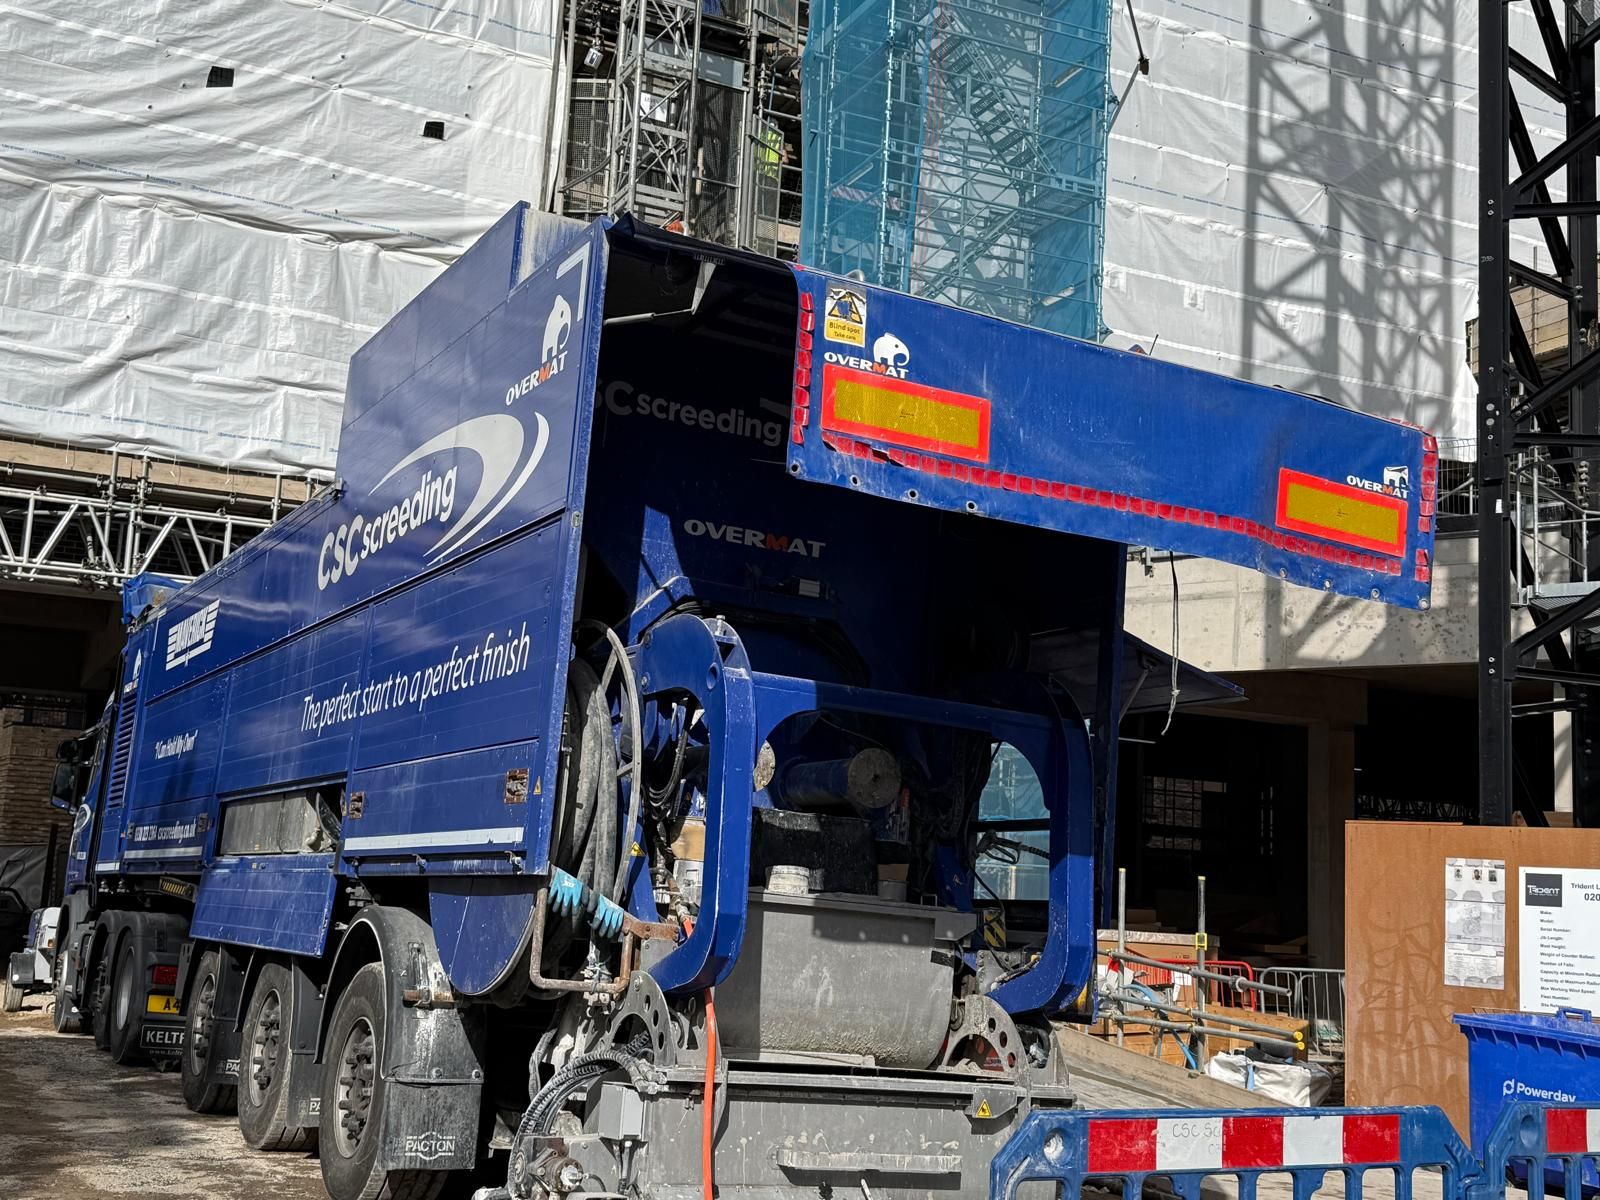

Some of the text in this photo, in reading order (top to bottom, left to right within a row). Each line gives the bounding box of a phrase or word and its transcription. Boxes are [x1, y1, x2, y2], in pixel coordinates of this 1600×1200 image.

[829, 321, 846, 331] Blind
[823, 351, 909, 379] OVERMAT
[505, 350, 568, 406] OVERMAT
[1346, 475, 1409, 499] OVERMAT
[683, 519, 826, 558] OVERMAT
[300, 620, 530, 737] The perfect start to a perfect finish
[1571, 882, 1595, 890] Trident
[1173, 1123, 1200, 1138] CSC
[405, 1140, 455, 1152] PACTON
